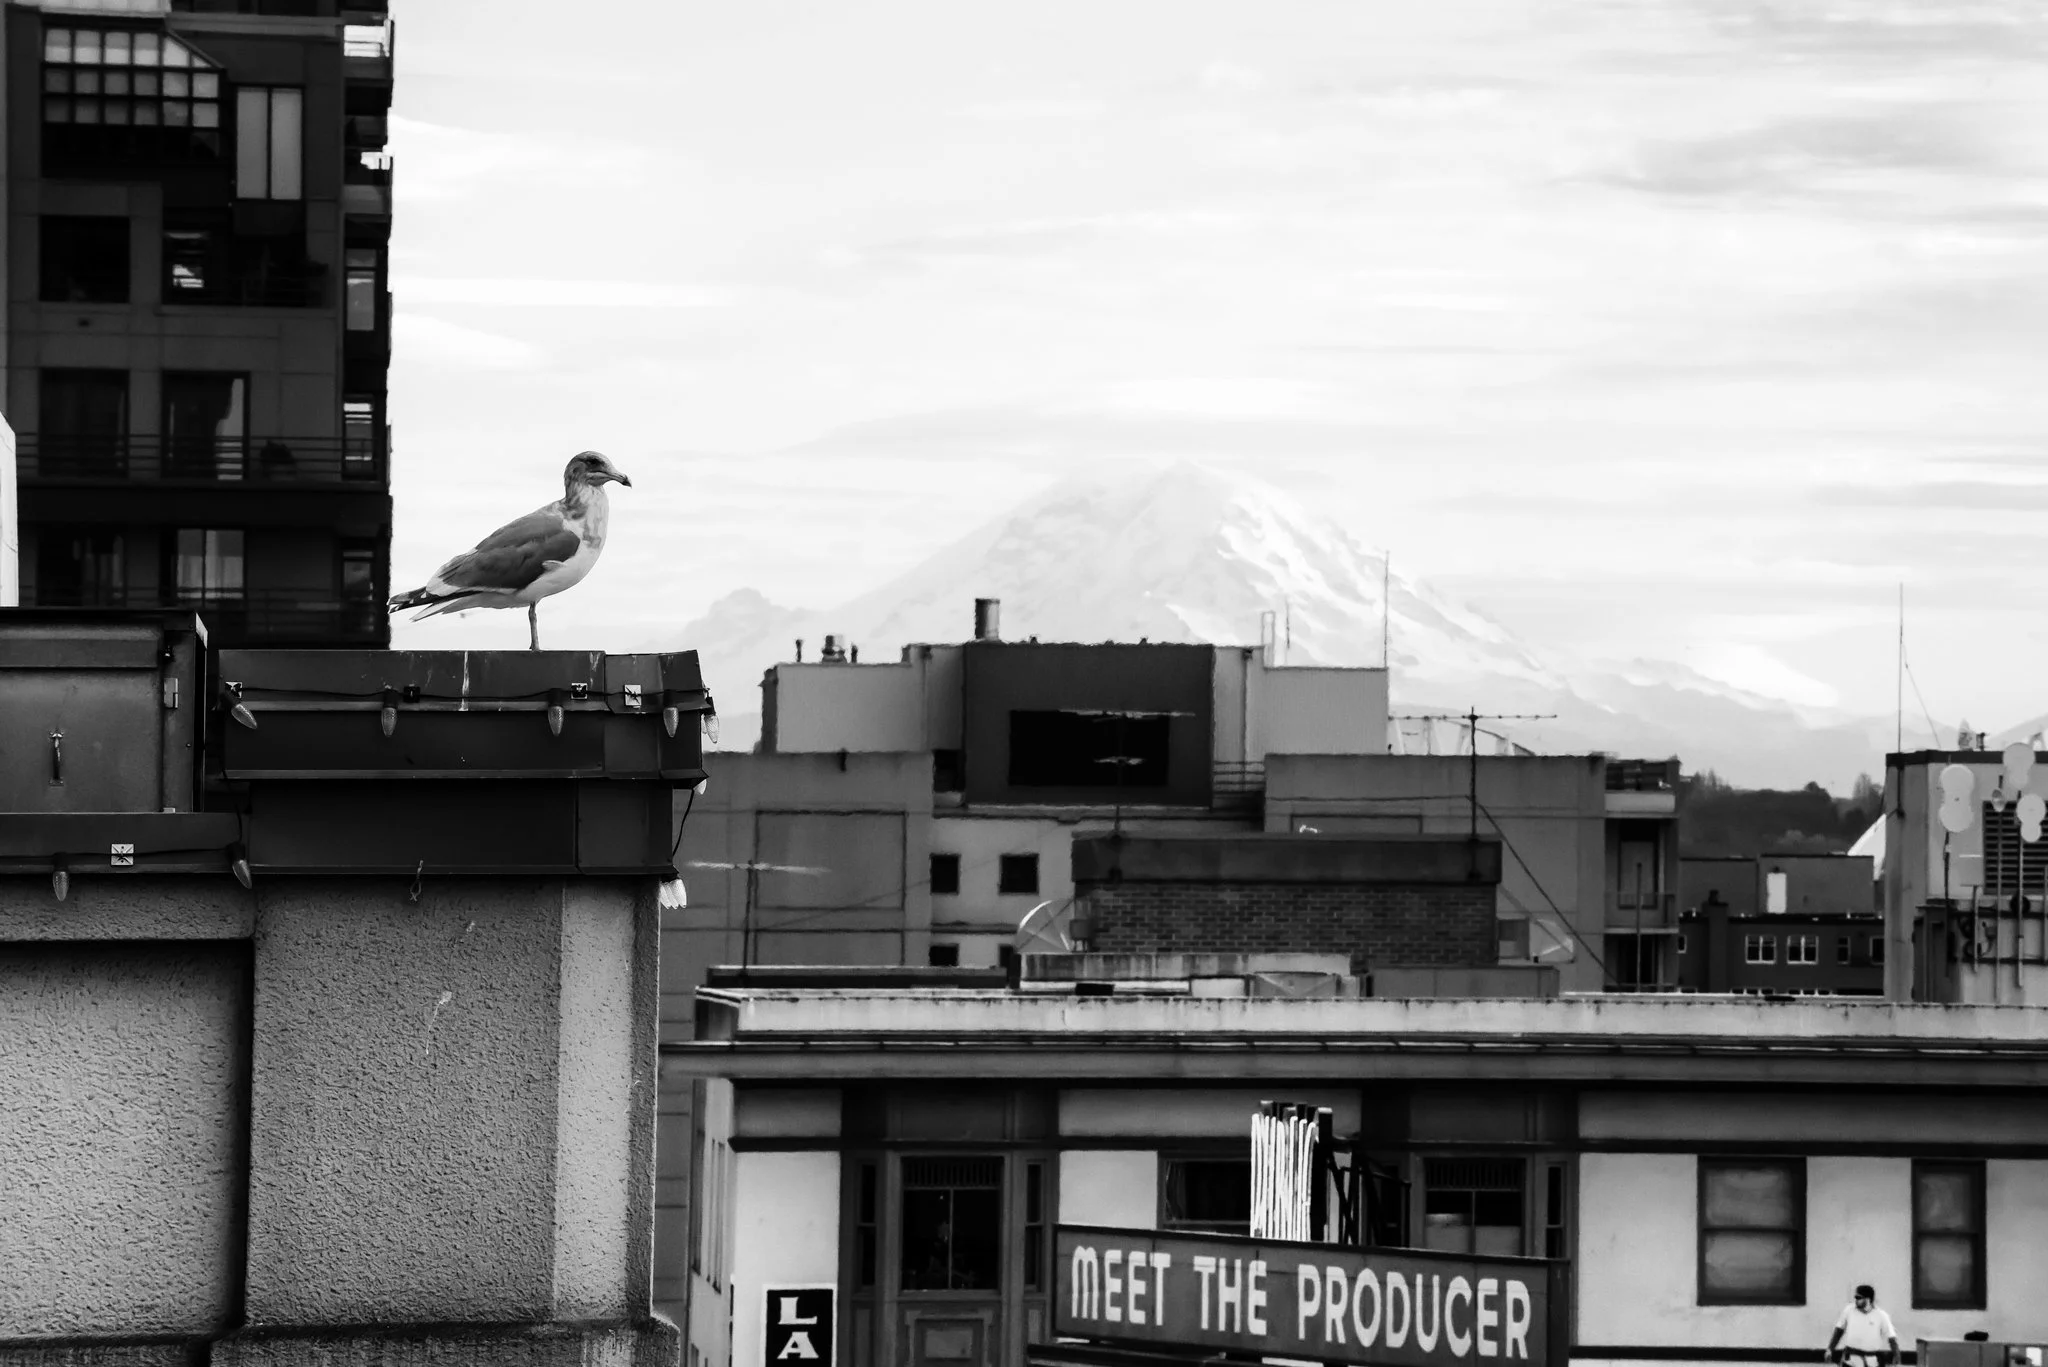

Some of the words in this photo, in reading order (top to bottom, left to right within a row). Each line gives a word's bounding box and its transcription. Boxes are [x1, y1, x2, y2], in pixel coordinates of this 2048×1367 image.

[1071, 1246, 1171, 1326] MEET
[1193, 1255, 1267, 1336] THE
[1297, 1264, 1531, 1359] PRODUCER
